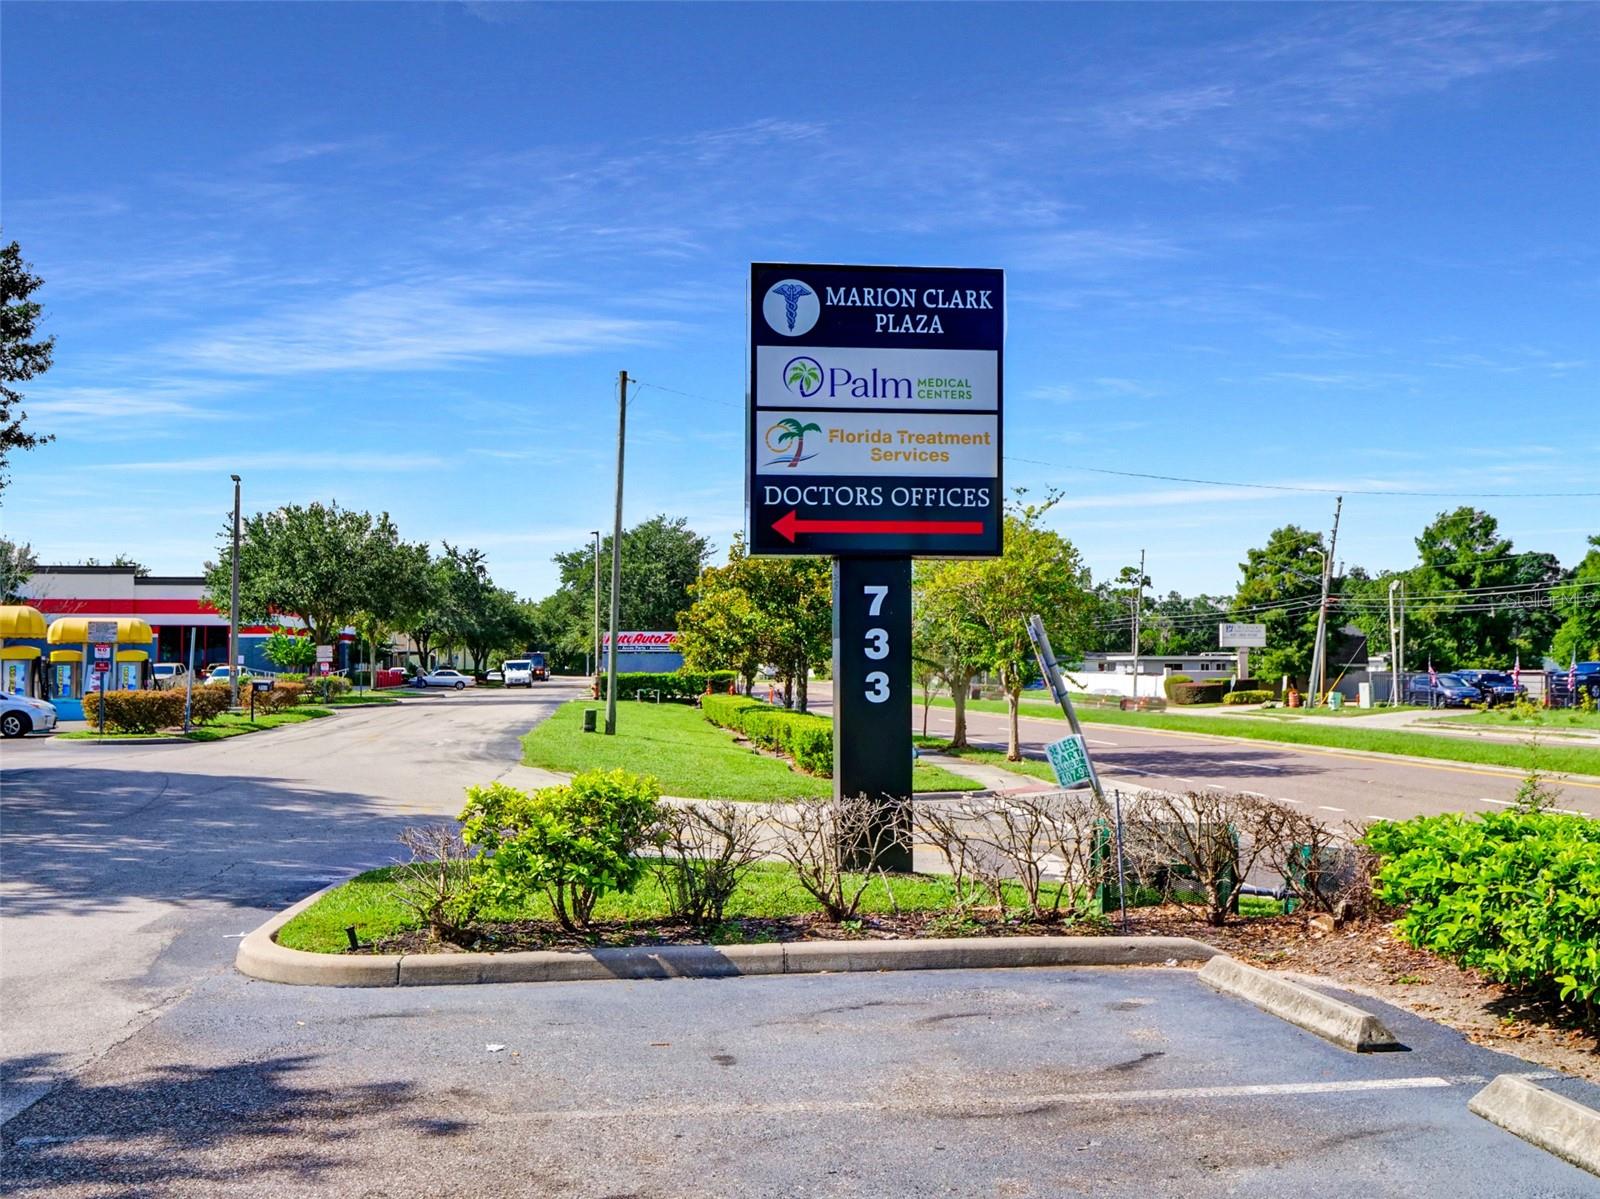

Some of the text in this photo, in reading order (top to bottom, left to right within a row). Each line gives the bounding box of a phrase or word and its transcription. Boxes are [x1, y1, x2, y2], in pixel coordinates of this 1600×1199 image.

[825, 286, 994, 310] MARION CLARK
[875, 313, 945, 334] PLAZA
[829, 367, 913, 400] Palm
[917, 377, 972, 389] MEDICAL
[917, 389, 973, 400] CENTERS
[828, 428, 991, 446] Florida Treatment
[870, 447, 950, 463] Services
[763, 485, 991, 508] DOCTORS OFFICES
[863, 585, 890, 703] 733
